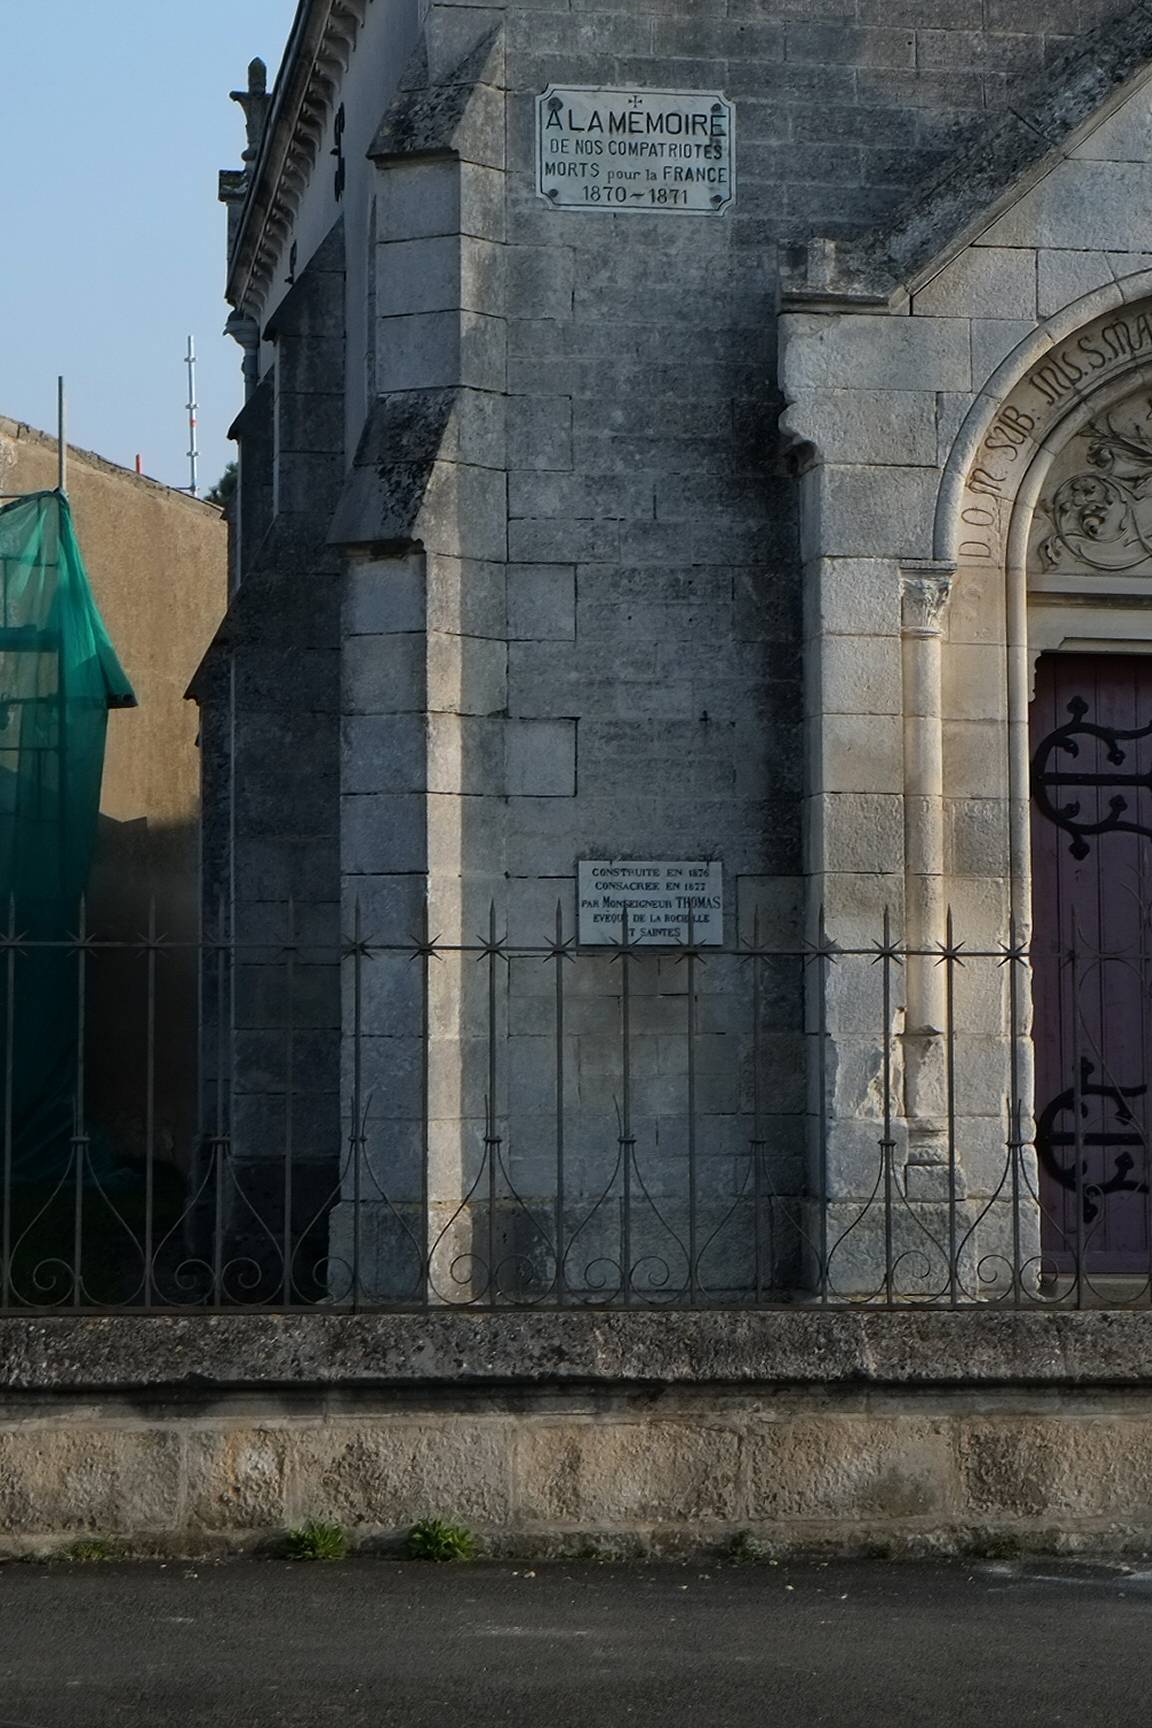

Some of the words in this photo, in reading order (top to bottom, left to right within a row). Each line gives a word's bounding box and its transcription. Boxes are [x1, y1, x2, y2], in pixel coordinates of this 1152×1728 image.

[568, 109, 604, 134] LA
[608, 111, 727, 137] MEMOIRE
[551, 138, 569, 154] DE
[575, 139, 603, 155] NOS
[608, 140, 723, 160] COMPATRIOTES
[545, 161, 600, 178] MORTS
[607, 171, 641, 184] pour
[646, 170, 657, 181] la
[663, 165, 728, 183] FRANCE
[592, 868, 660, 878] CONSTRUITE
[666, 868, 682, 877] EN
[665, 882, 680, 890] EN
[581, 899, 599, 908] PAR
[675, 896, 721, 909] THOMAS
[633, 914, 646, 922] DE
[650, 914, 661, 922] LA
[640, 928, 681, 937] SAINTES
